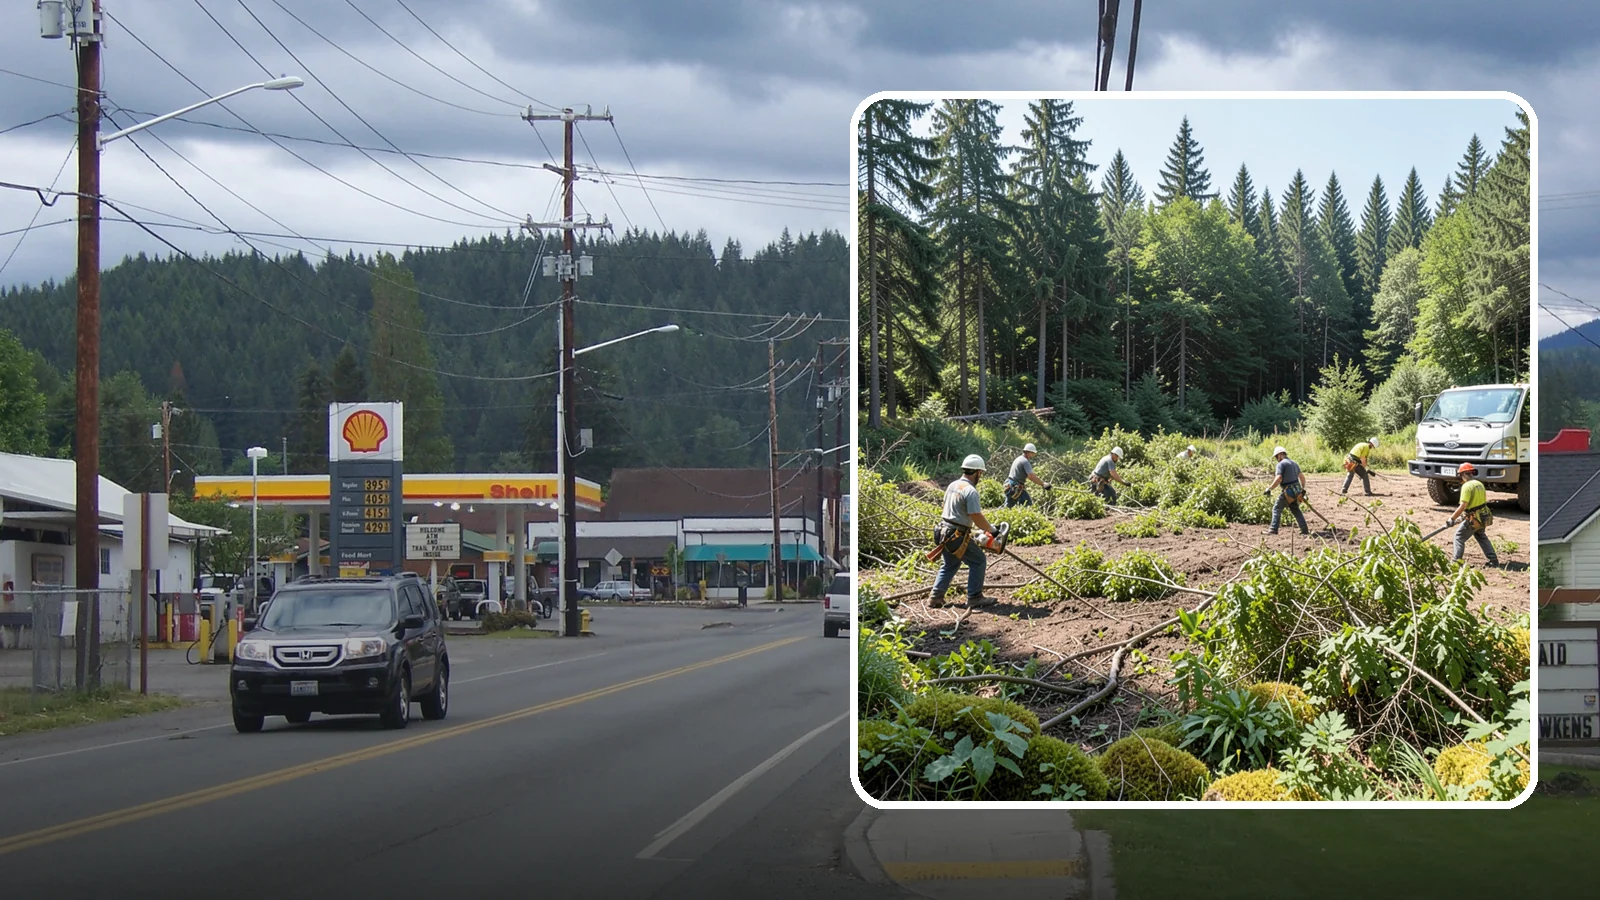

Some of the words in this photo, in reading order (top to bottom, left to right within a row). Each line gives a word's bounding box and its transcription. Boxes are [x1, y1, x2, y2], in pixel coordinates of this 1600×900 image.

[365, 480, 384, 490] 395
[490, 484, 548, 499] Shell
[365, 494, 384, 504] 405
[365, 508, 384, 518] 415
[365, 522, 384, 532] 429
[1538, 643, 1567, 665] AID
